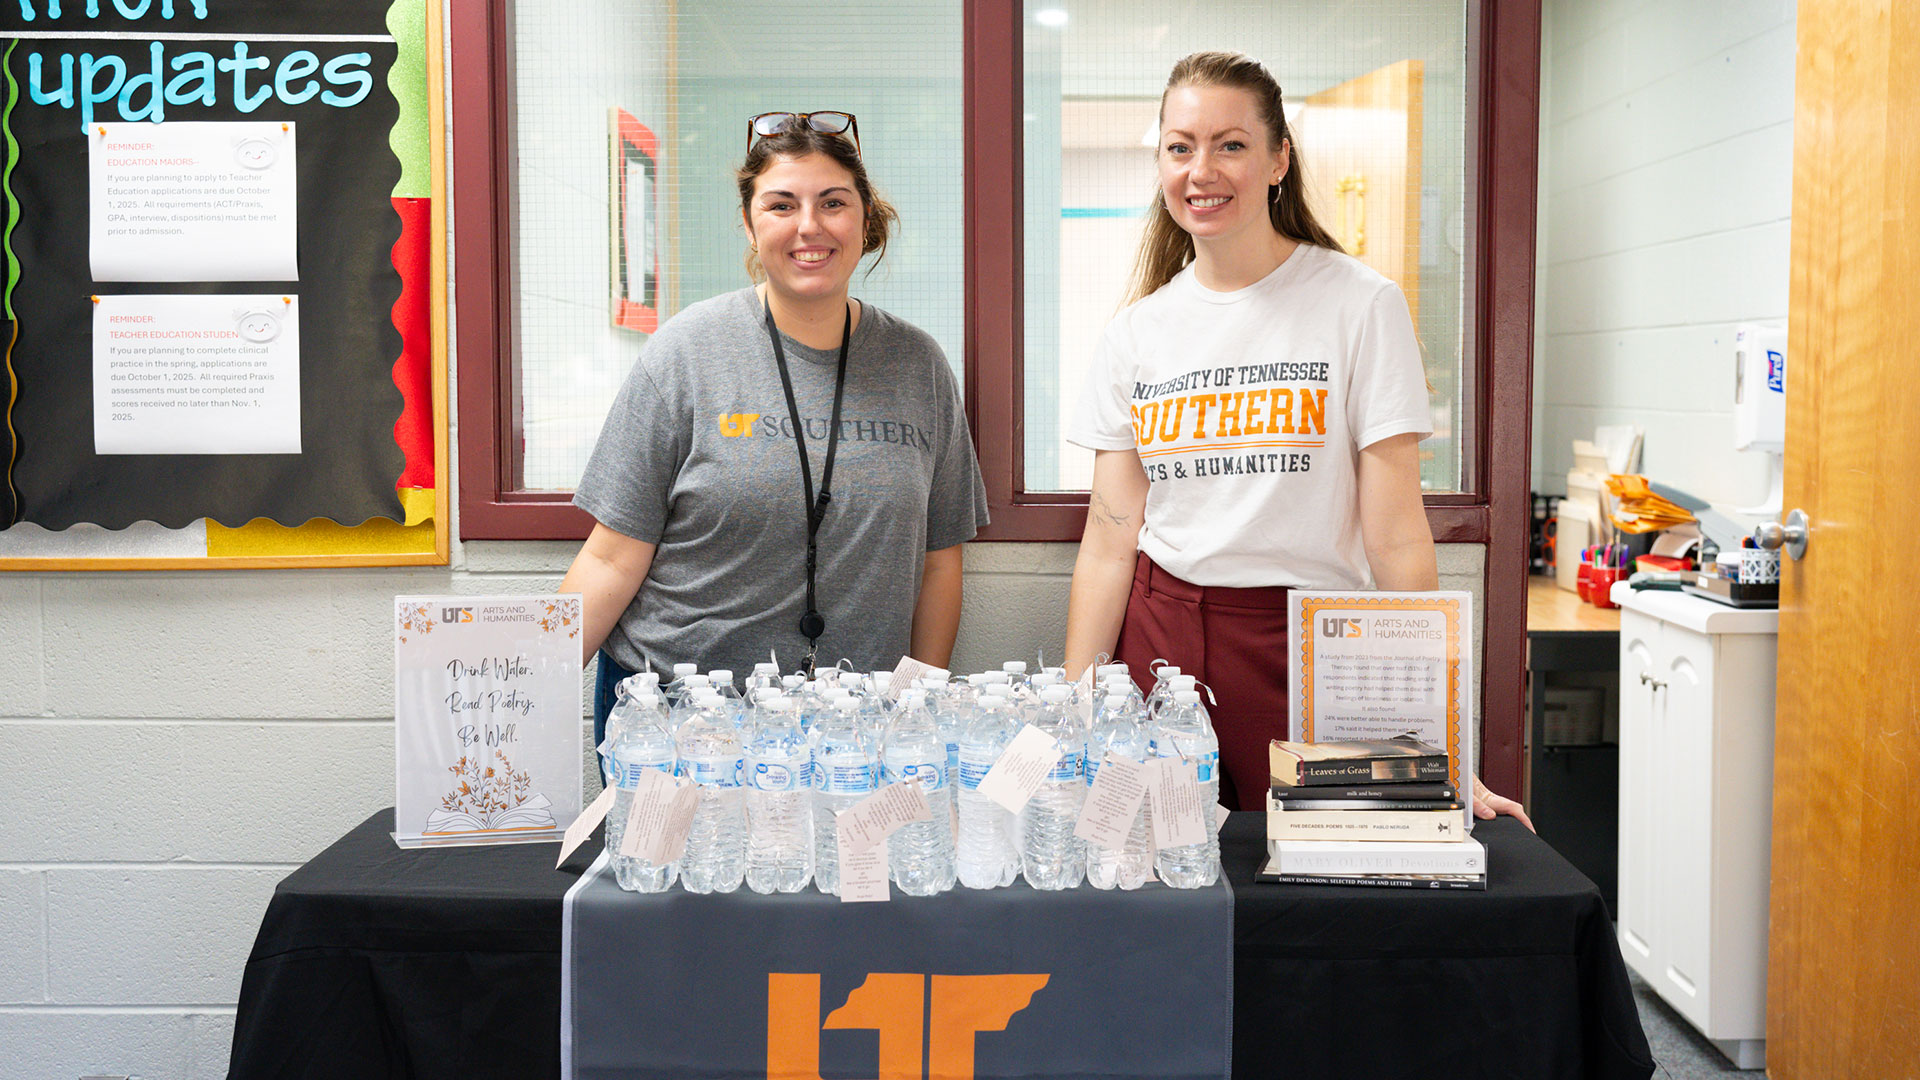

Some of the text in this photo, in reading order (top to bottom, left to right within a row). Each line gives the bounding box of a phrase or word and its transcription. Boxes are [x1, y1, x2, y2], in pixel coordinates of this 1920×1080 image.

[29, 41, 372, 135] updates
[107, 143, 154, 151] REMINDER:
[107, 158, 158, 167] EDUCATION
[114, 175, 130, 183] you
[146, 174, 182, 183] planning
[194, 174, 217, 183] apply
[150, 188, 202, 196] applications
[156, 201, 212, 210] requirements
[213, 201, 263, 210] (ACT/Praxis,
[107, 214, 128, 223] GPA,
[129, 214, 170, 223] interview,
[170, 214, 224, 223] dispositions)
[107, 228, 127, 237] prior
[109, 315, 155, 323] REMINDER:
[109, 331, 239, 339] TEACHER EDUCATION STUDEN
[116, 348, 132, 356] you
[148, 347, 185, 356] planning
[196, 347, 236, 356] complete
[110, 360, 143, 369] practice
[170, 360, 198, 369] spring,
[200, 360, 252, 369] applications
[110, 373, 126, 381] due
[127, 373, 161, 381] October
[172, 373, 196, 381] 2025.
[200, 373, 211, 381] All
[212, 373, 247, 382] required
[249, 373, 274, 381] Praxis
[1133, 361, 1330, 400] NIVERSITY OF TENNESSEE
[201, 387, 246, 395] completed
[112, 413, 135, 421] 2025.
[1130, 387, 1329, 447] SOUTHERN
[719, 413, 934, 452] UT SOUTHERN
[1174, 461, 1189, 479] &
[1195, 453, 1312, 478] HUMANITIES
[507, 606, 526, 614] AND
[483, 615, 536, 623] HUMANITIES
[1374, 618, 1402, 629] ARTS
[1404, 618, 1429, 628] AND
[1374, 629, 1443, 640] HUMANITIES
[446, 658, 489, 682] Drink
[444, 689, 535, 716] Read Poetry.
[457, 723, 518, 748] Be Well.
[1310, 767, 1337, 776] Leaves
[1346, 766, 1370, 775] Grass
[1293, 857, 1460, 868] MARY OLIVER Devotions
